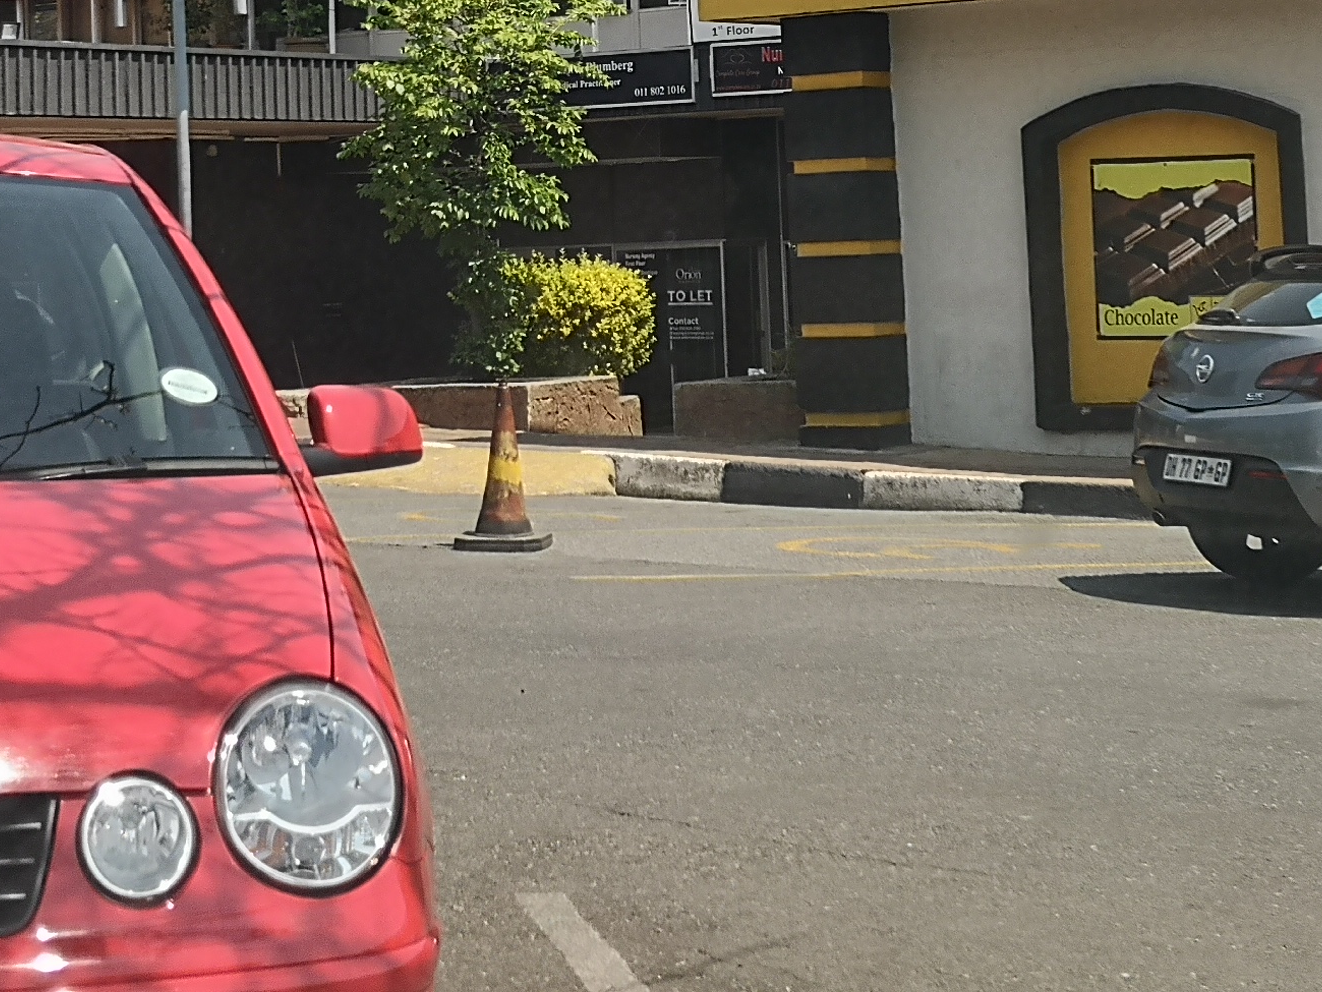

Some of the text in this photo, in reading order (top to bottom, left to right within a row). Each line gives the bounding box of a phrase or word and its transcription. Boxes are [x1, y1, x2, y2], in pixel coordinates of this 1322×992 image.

[712, 25, 754, 36] 1st Floor
[634, 85, 686, 97] 011 802 1016
[667, 290, 712, 302] TO LET
[668, 317, 699, 325] Contact
[1104, 309, 1178, 326] Chocolate
